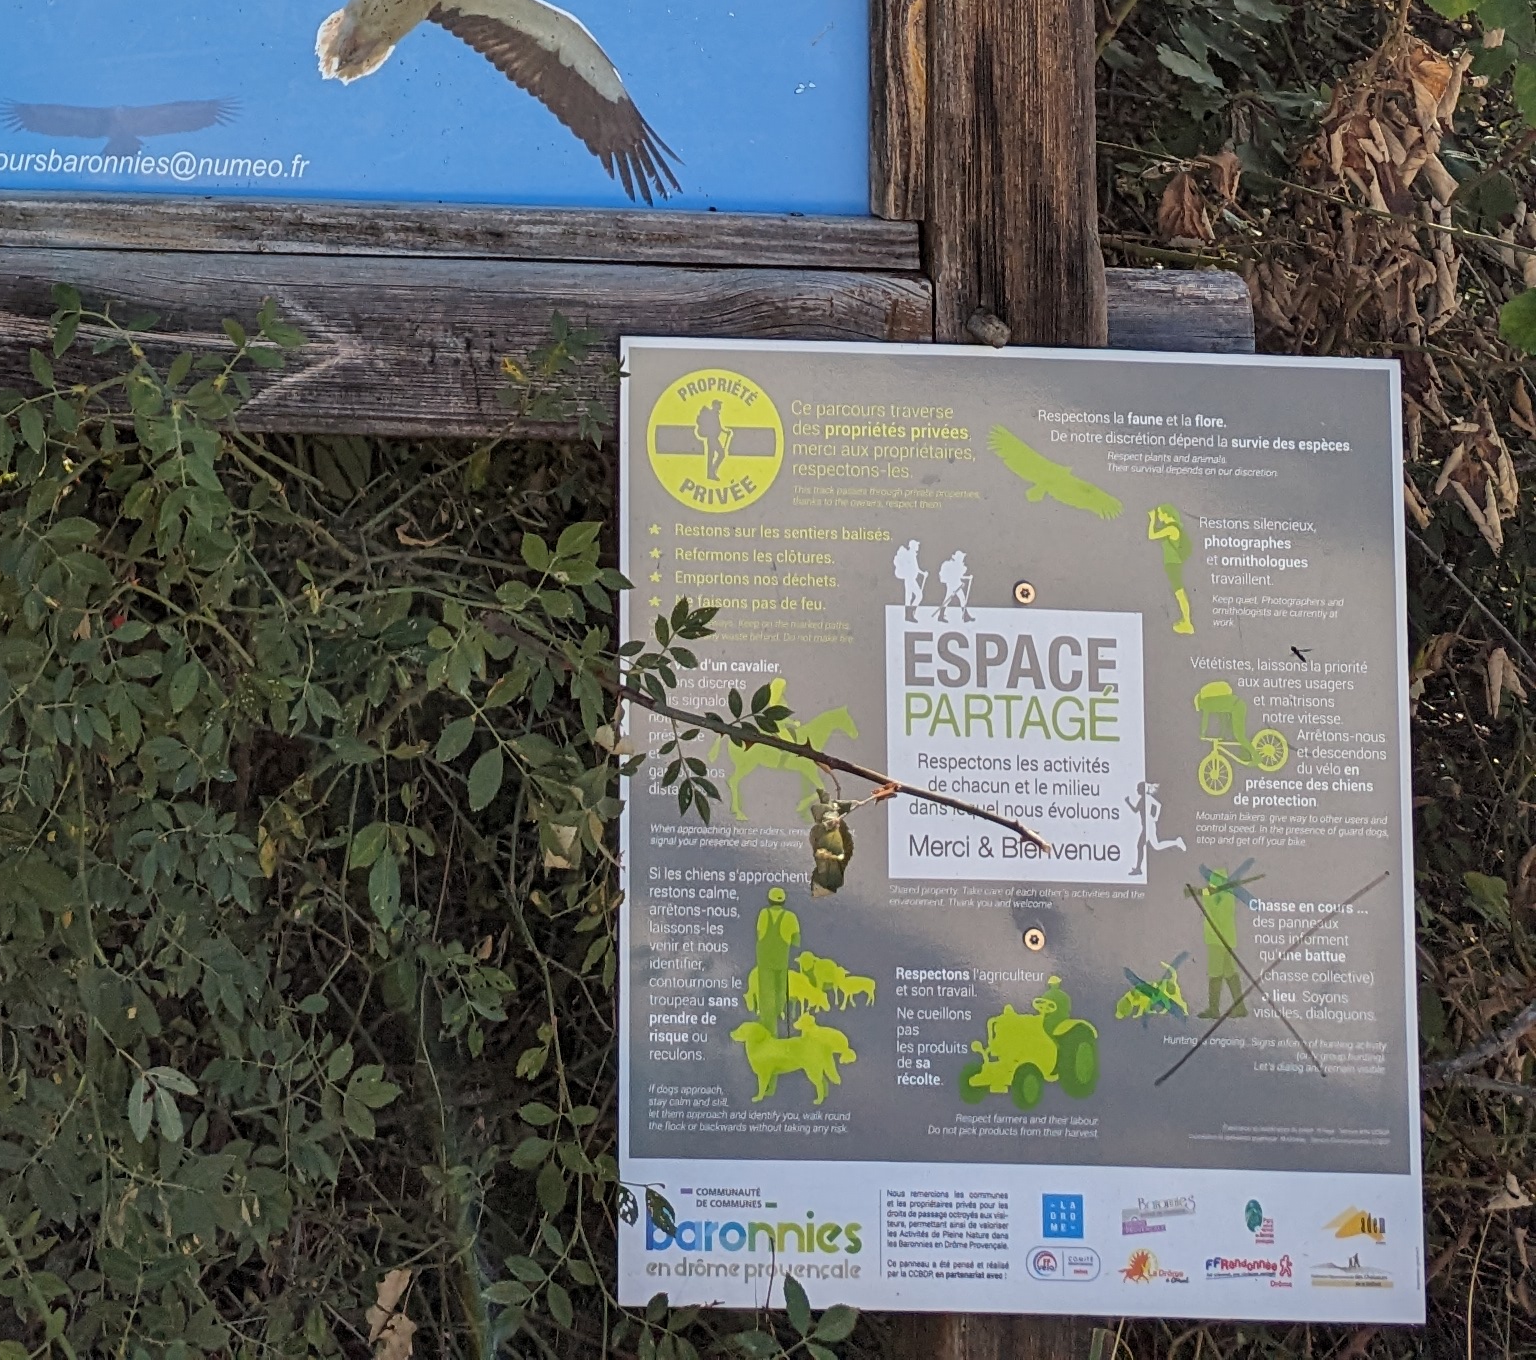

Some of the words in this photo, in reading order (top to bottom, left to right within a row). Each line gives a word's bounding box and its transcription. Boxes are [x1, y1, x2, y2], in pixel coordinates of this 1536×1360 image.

[677, 376, 760, 407] PROPRIÉTÉ
[791, 399, 813, 417] Ce
[816, 403, 888, 422] parcours
[890, 403, 955, 420] traverse
[1038, 409, 1111, 425] Respectons
[1113, 411, 1125, 425] la
[1127, 411, 1164, 426] faune
[1165, 414, 1179, 427] et
[1181, 413, 1192, 427] la
[792, 421, 822, 437] des
[825, 422, 908, 442] propriétés
[1050, 429, 1068, 442] De
[1070, 432, 1103, 444] notre
[1105, 430, 1166, 446] discrétion
[1168, 432, 1214, 449] dépend
[1217, 434, 1228, 448] la
[1231, 435, 1270, 449] survie
[1272, 436, 1296, 450] des
[792, 443, 836, 456] merci
[840, 444, 869, 458] aux
[679, 474, 758, 506] PRIVÉE
[675, 523, 731, 538] Restons
[734, 527, 757, 538] sur
[760, 524, 780, 539] les
[784, 525, 838, 540] sentiers
[1199, 516, 1250, 530] Restons
[1204, 534, 1292, 552] photographes
[753, 548, 773, 563] les
[1206, 554, 1218, 566] et
[1221, 553, 1309, 571] ornithologues
[903, 631, 1120, 694] ESPACE
[904, 686, 1122, 743] PARTAGÉ
[918, 752, 1012, 774] Respectons
[1016, 754, 1039, 772] les
[1043, 755, 1110, 774] activités
[927, 776, 949, 794] de
[951, 775, 1010, 794] chacun
[1014, 779, 1030, 795] et
[1034, 777, 1048, 795] le
[1052, 779, 1100, 797] milieu
[1245, 777, 1303, 793] présence
[1305, 777, 1329, 791] des
[1331, 778, 1374, 792] chiens
[1233, 792, 1250, 806] de
[909, 834, 970, 858] Merci
[649, 866, 661, 880] Si
[664, 866, 682, 881] les
[684, 867, 726, 882] chiens
[648, 886, 698, 899] restons
[1249, 898, 1297, 913] Chasse
[1298, 902, 1315, 913] en
[1317, 903, 1354, 914] cours
[896, 966, 971, 985] Respectons
[695, 1187, 761, 1197] COMMUNAUTÉ
[696, 1199, 708, 1208] DE
[709, 1199, 763, 1209] COMMUNES
[645, 1208, 864, 1254] baronnies
[645, 1262, 671, 1277] en
[674, 1256, 741, 1278] drôme
